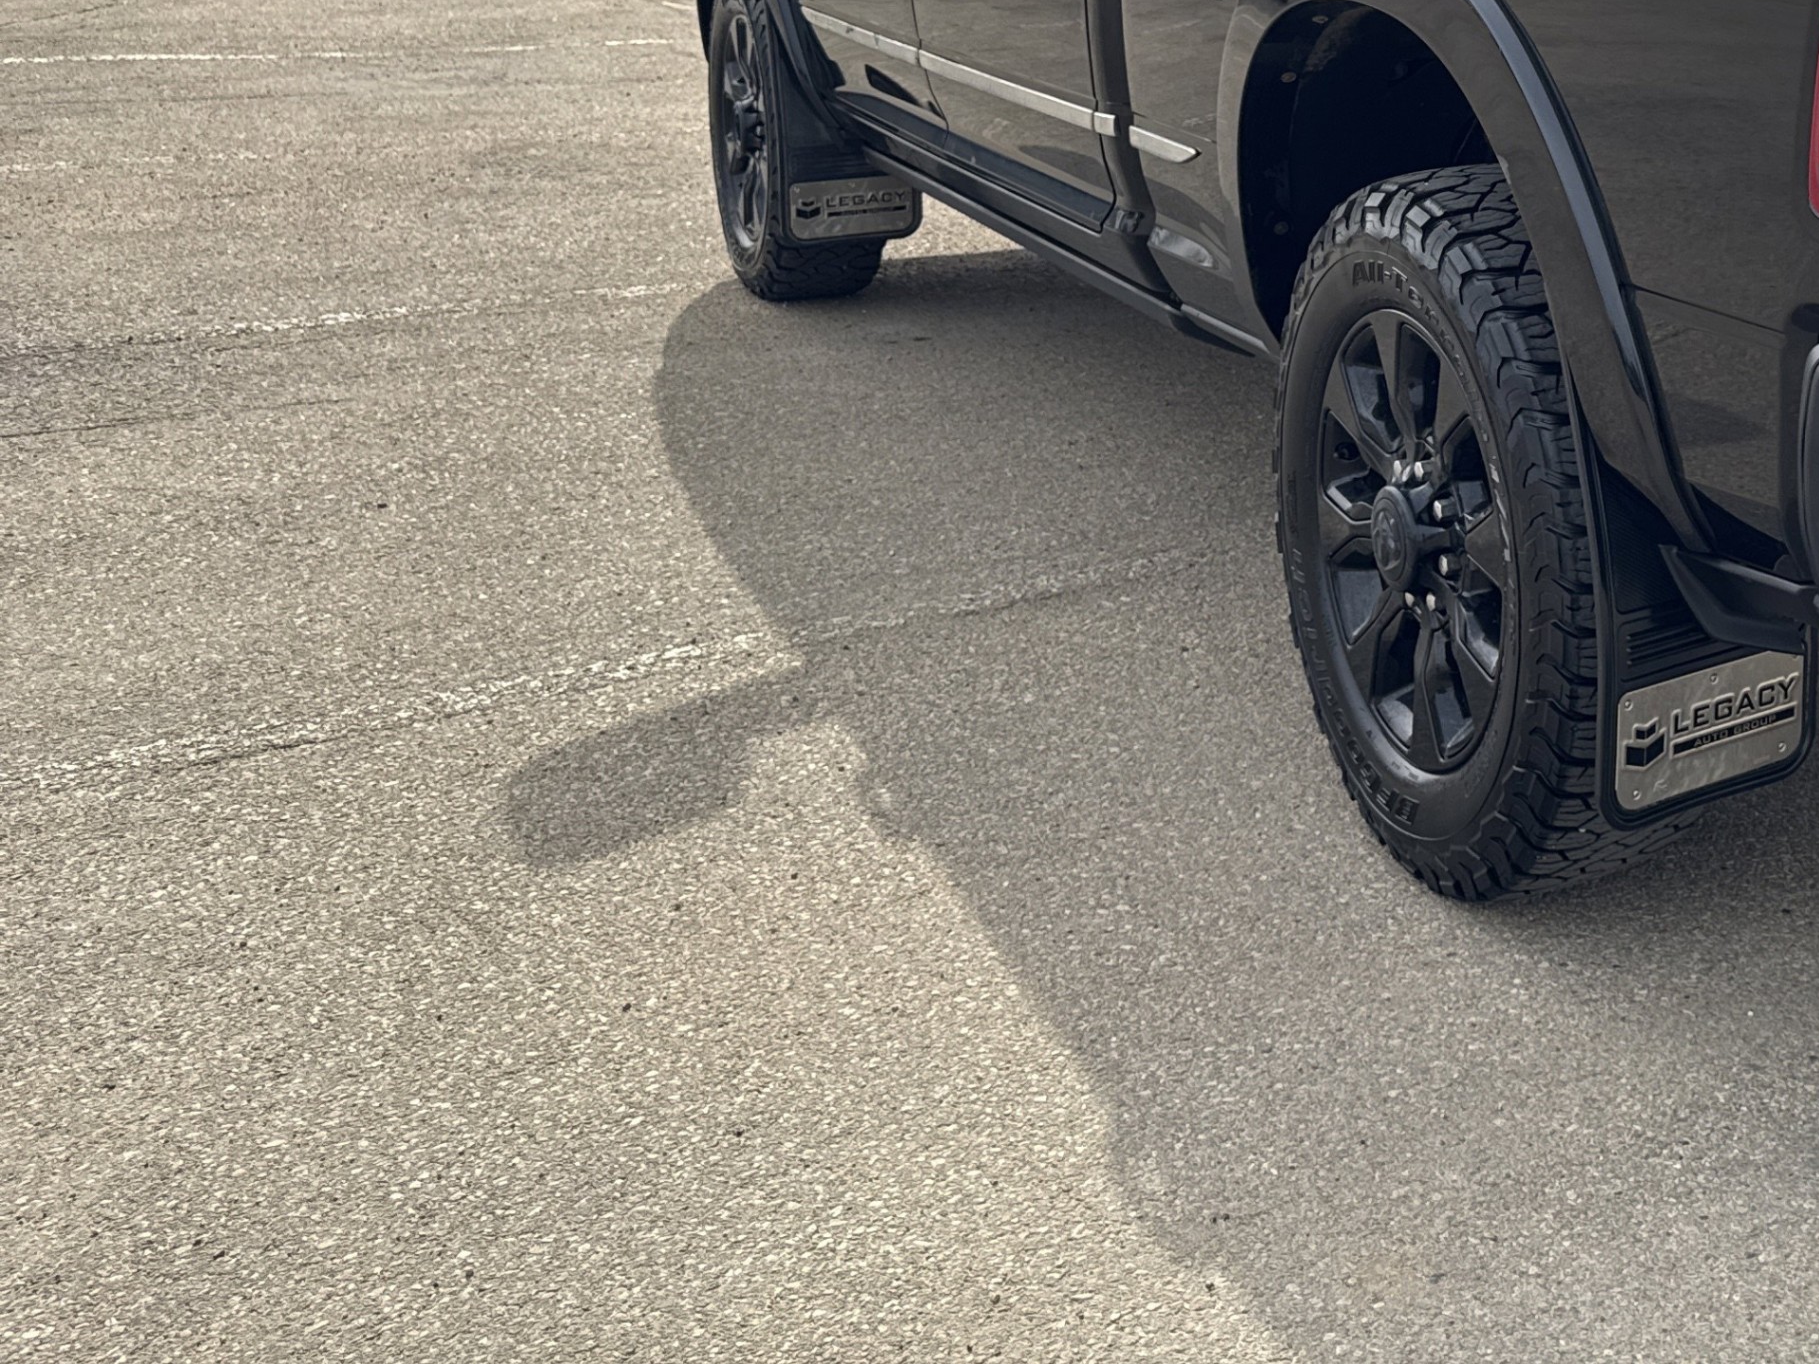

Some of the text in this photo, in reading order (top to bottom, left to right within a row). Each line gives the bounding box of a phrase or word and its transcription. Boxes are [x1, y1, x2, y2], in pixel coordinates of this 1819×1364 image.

[825, 191, 906, 208] LEGACY
[1671, 674, 1798, 737] LEGACY
[1693, 714, 1777, 748] AUTO GROUP
